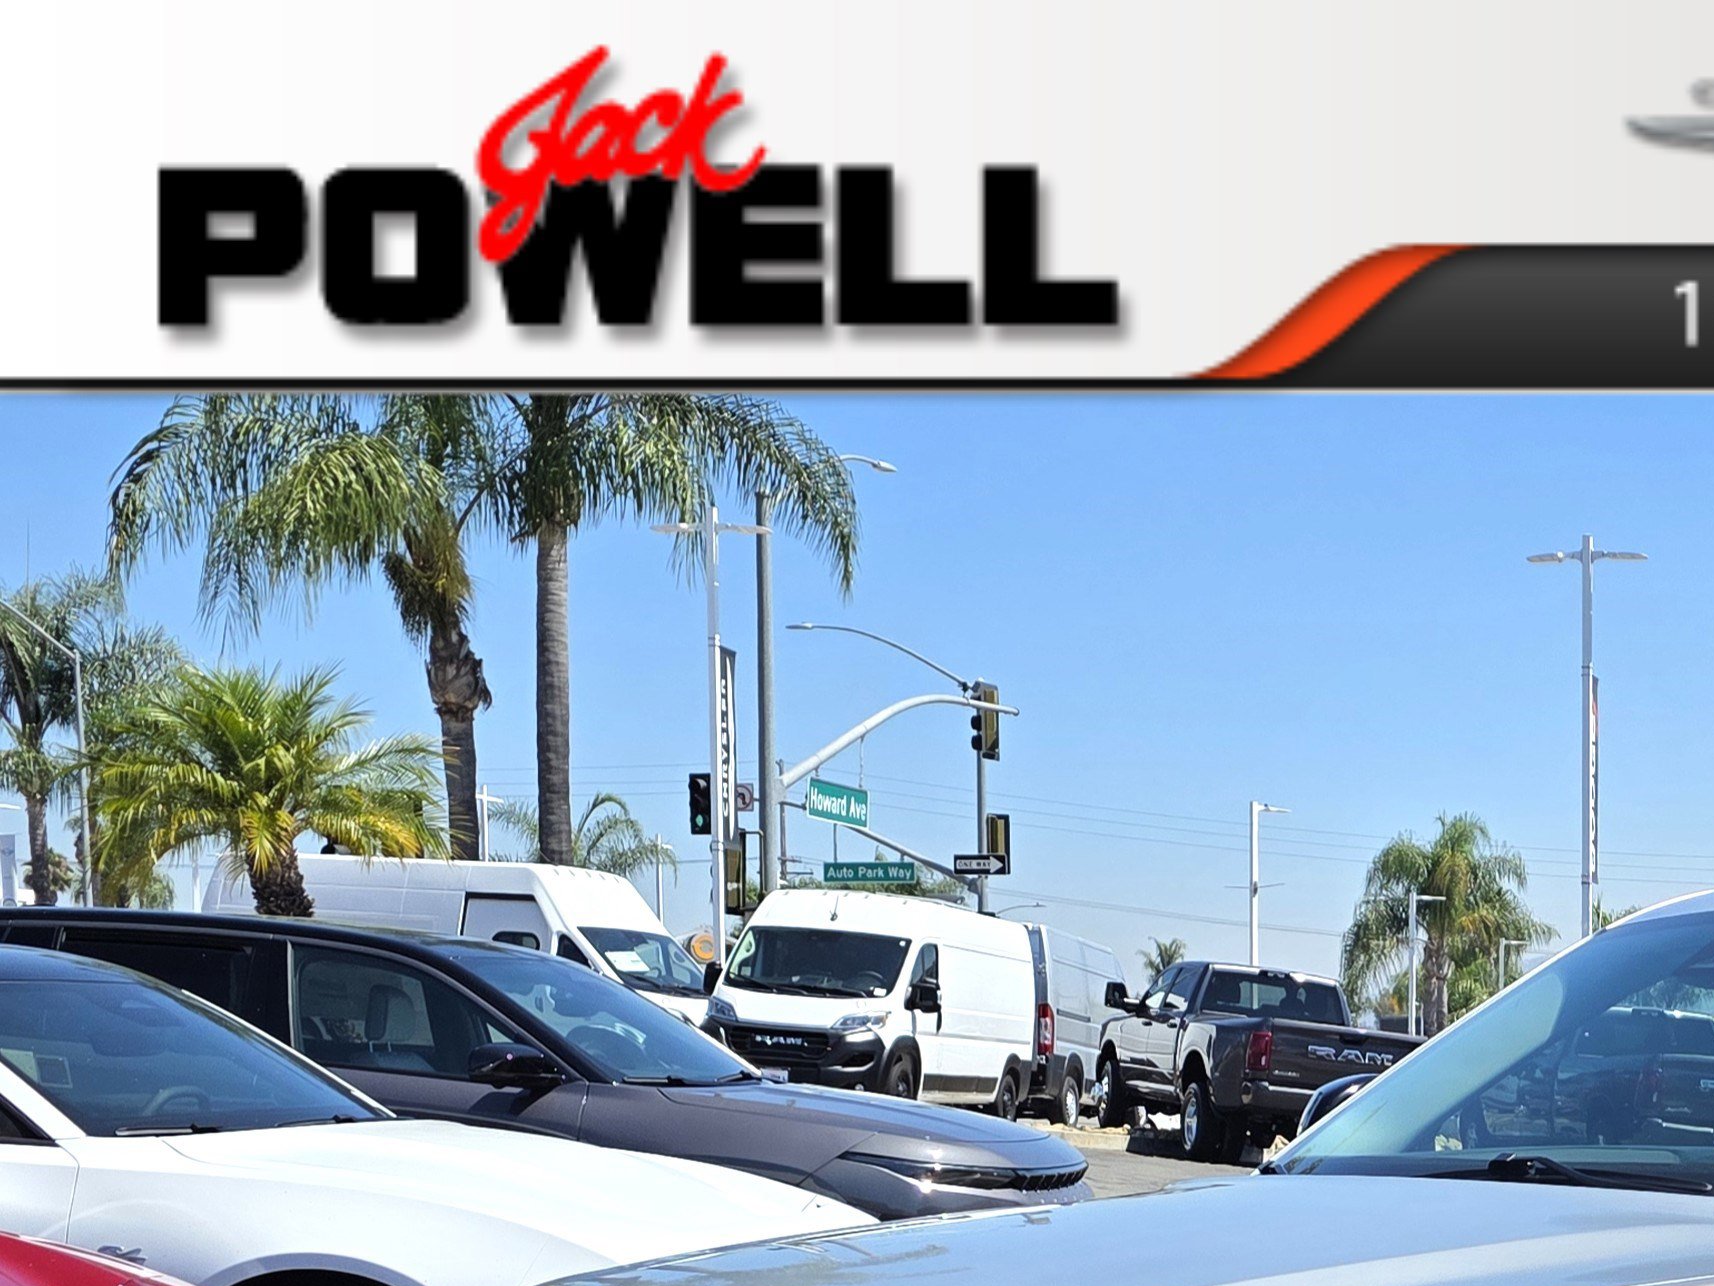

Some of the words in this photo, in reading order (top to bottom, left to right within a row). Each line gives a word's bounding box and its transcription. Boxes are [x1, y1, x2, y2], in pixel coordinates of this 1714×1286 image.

[721, 678, 729, 817] CHRYSLER
[810, 786, 847, 816] Howard
[849, 799, 867, 821] Ave
[826, 866, 854, 879] Auto
[858, 865, 884, 879] Park
[887, 867, 912, 880] Way
[957, 860, 973, 868] ONE
[976, 860, 991, 868] WAY
[1308, 1045, 1394, 1067] RAM
